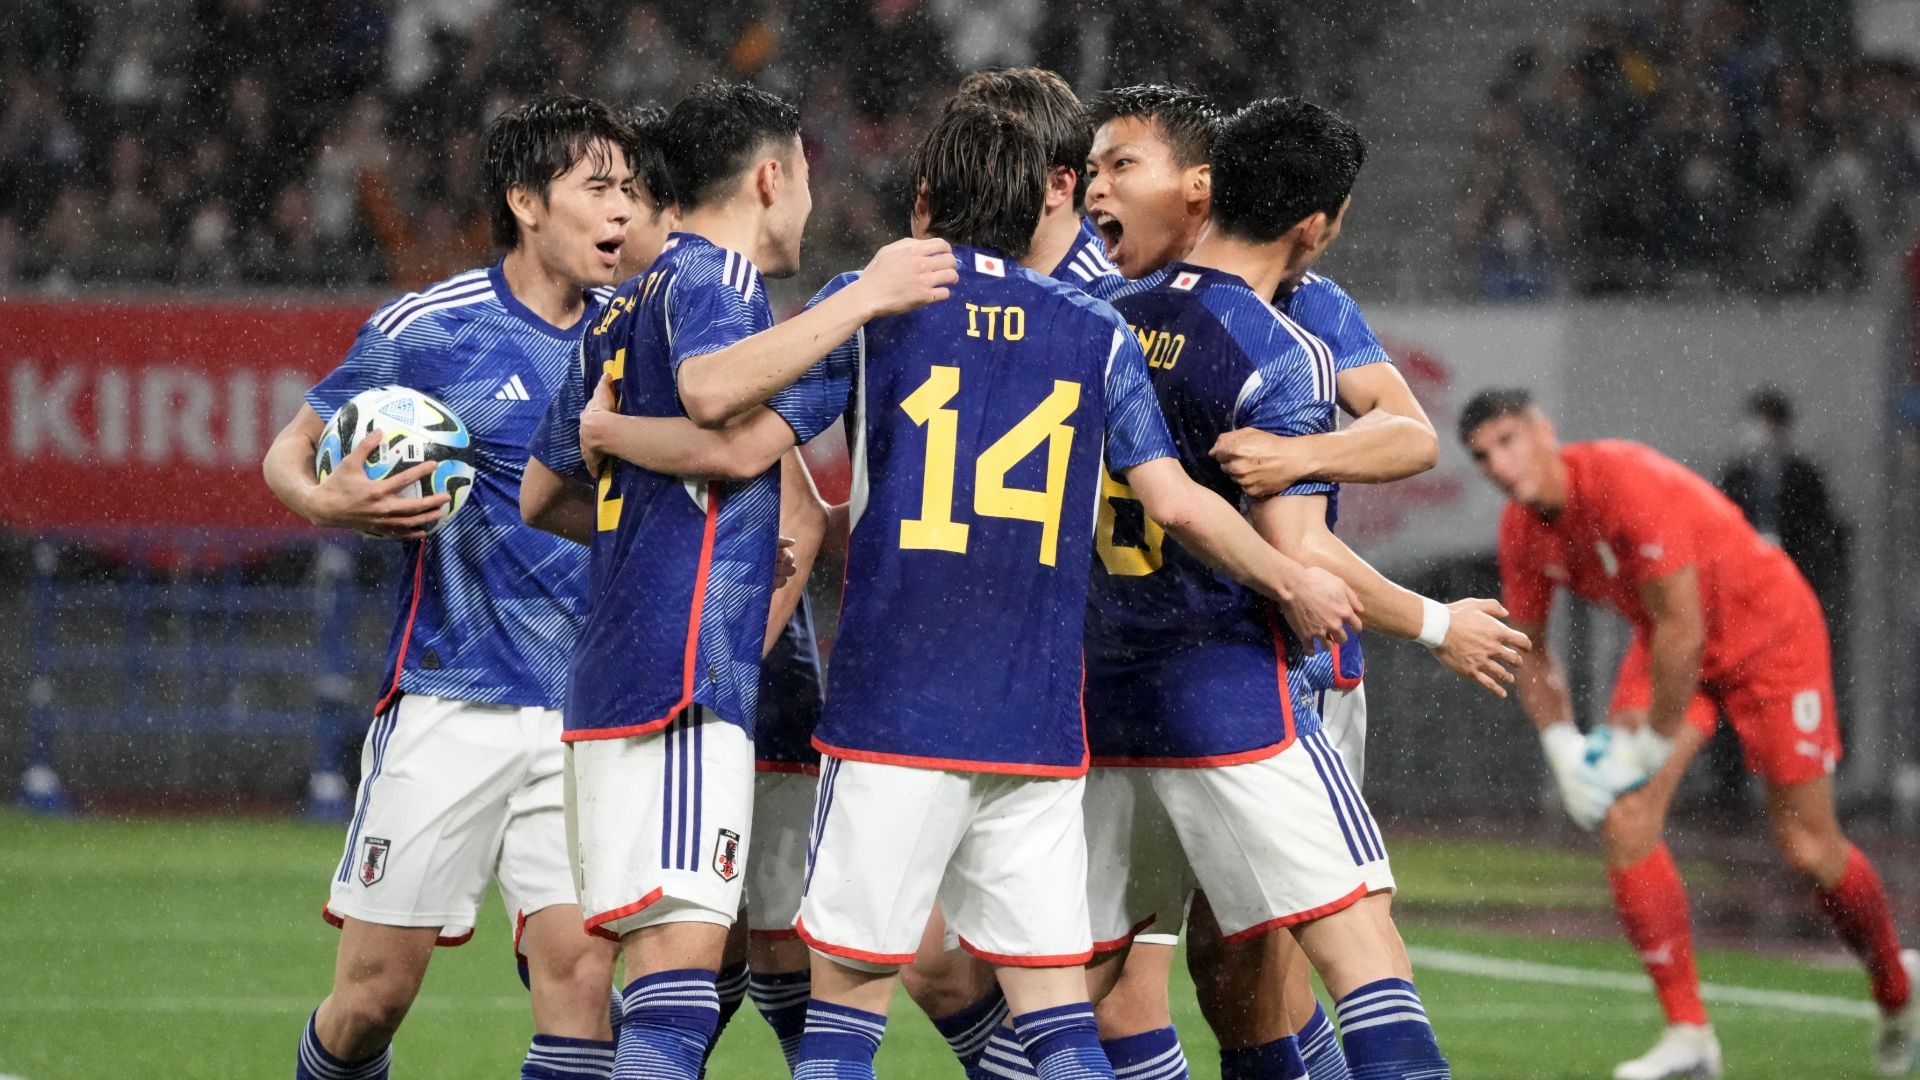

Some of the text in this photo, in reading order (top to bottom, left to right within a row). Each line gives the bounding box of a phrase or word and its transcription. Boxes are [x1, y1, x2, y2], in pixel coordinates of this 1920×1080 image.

[965, 303, 1025, 341] ITO
[1127, 324, 1186, 370] NDO
[899, 365, 1081, 568] 14
